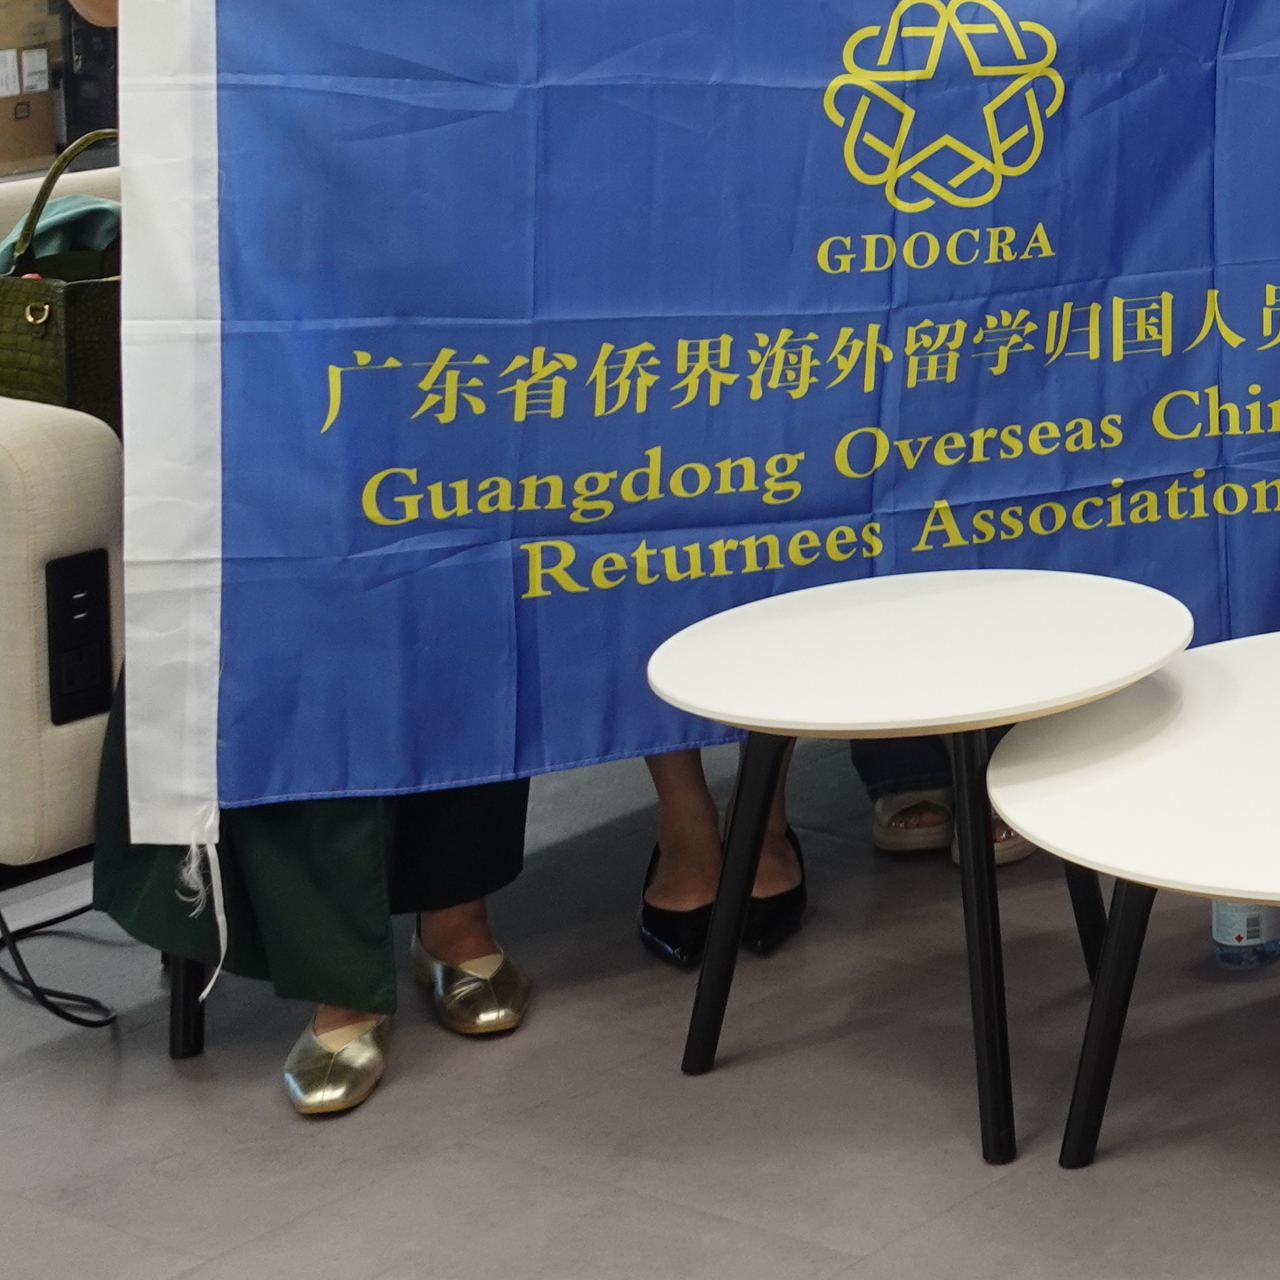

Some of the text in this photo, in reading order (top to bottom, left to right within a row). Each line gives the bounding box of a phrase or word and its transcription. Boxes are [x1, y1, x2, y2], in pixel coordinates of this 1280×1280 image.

[817, 222, 1056, 276] GDOCRA
[360, 444, 805, 528] Guangdong
[833, 413, 1124, 480] Overseas
[519, 512, 884, 600] Returnees
